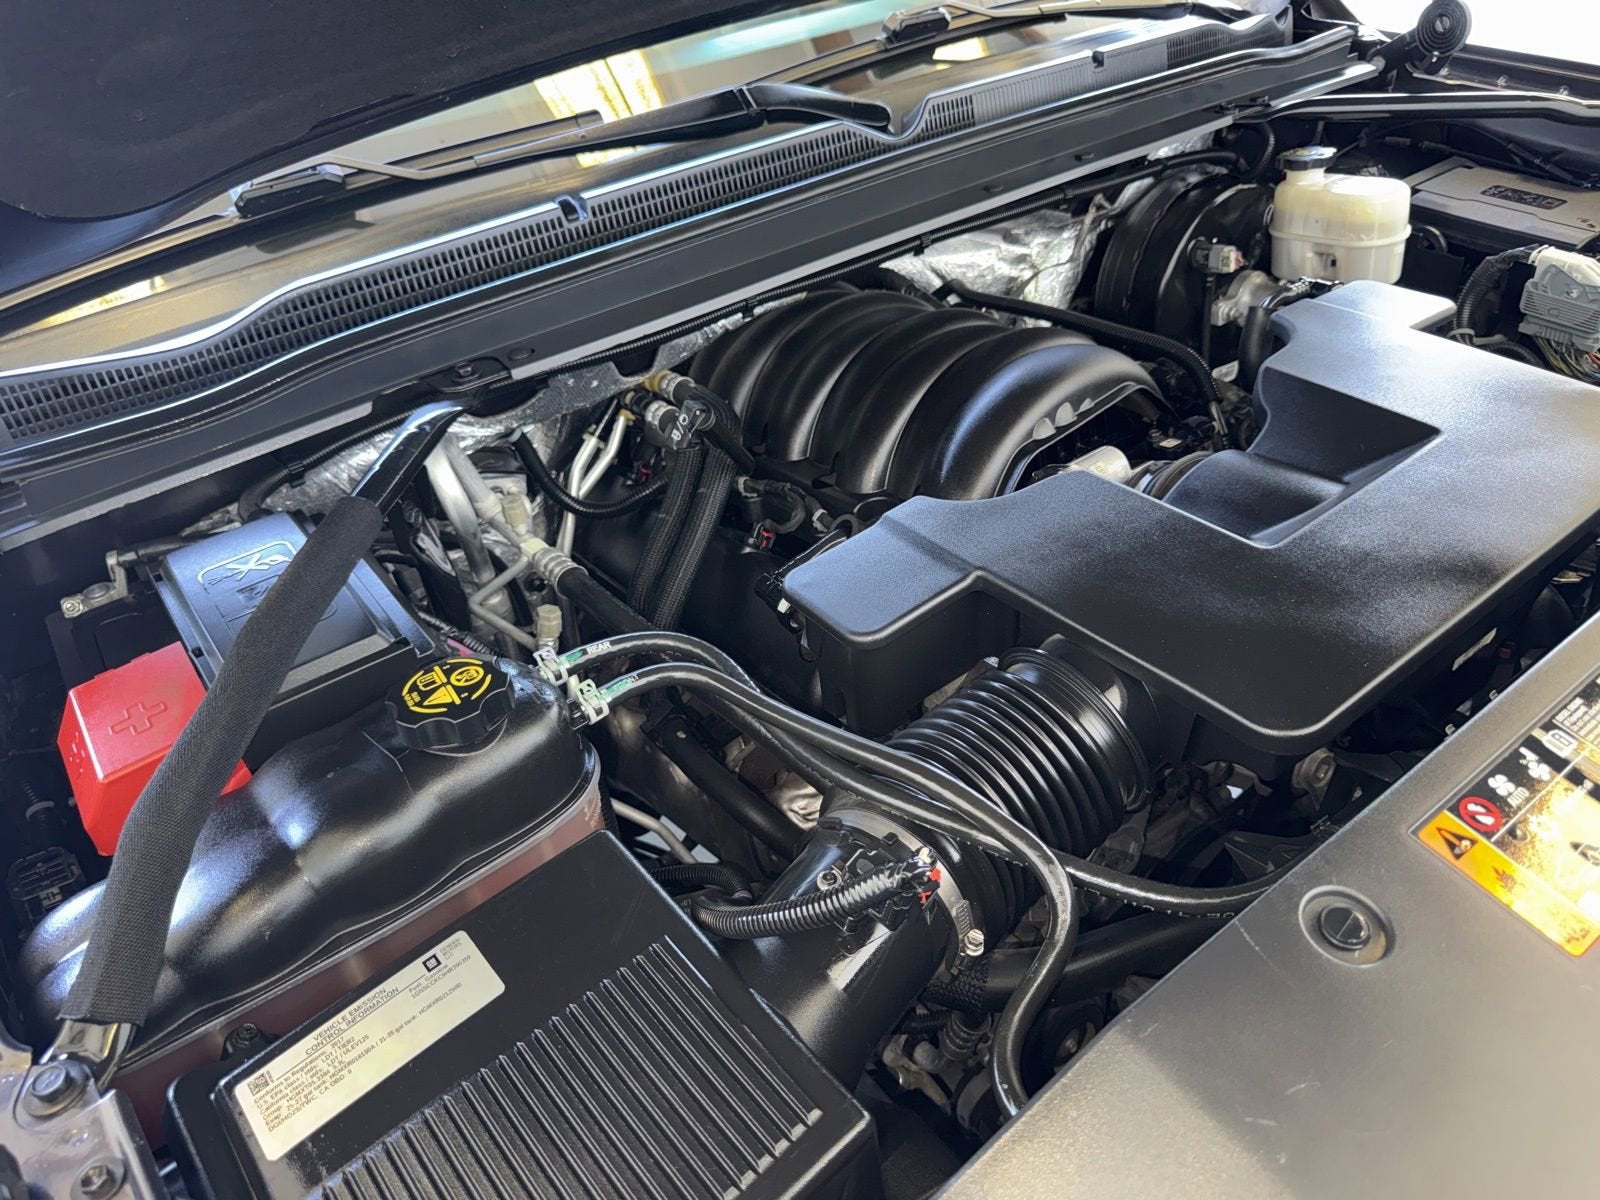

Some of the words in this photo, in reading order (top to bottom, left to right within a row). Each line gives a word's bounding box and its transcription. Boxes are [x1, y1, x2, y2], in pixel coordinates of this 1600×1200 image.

[586, 641, 611, 655] REAR
[304, 1024, 346, 1056] CONTROL
[344, 986, 399, 1027] INFORMATION
[312, 1014, 348, 1042] VEHICLE
[348, 987, 386, 1017] EMISSION
[329, 1036, 345, 1049] 2017
[269, 1087, 283, 1100] EPA
[320, 1051, 334, 1063] LDT
[337, 1035, 355, 1051] TIER2
[326, 1055, 339, 1067] LDT
